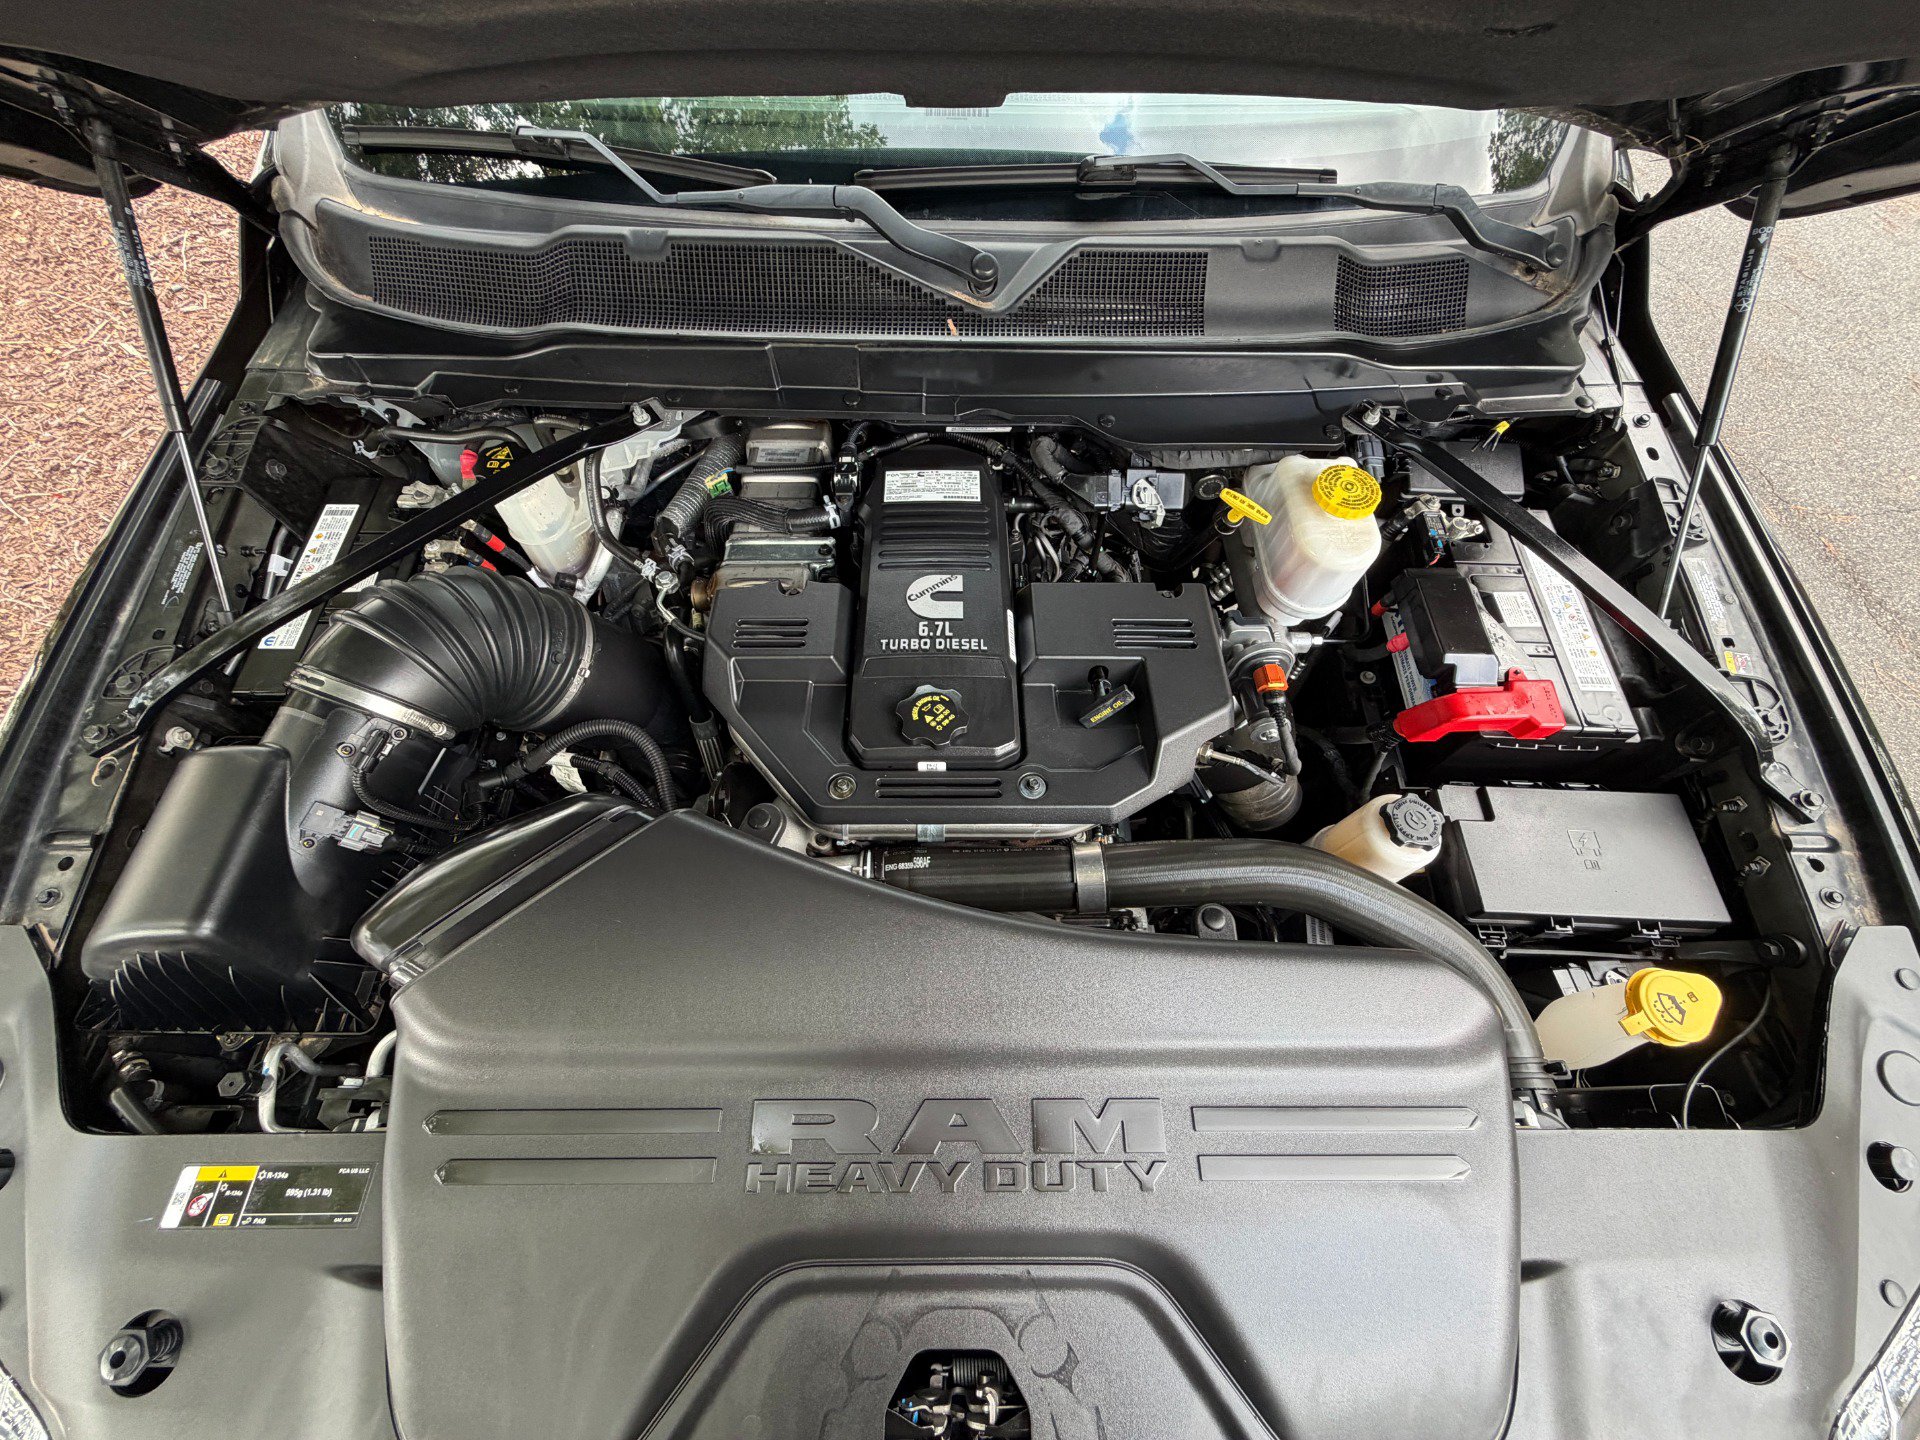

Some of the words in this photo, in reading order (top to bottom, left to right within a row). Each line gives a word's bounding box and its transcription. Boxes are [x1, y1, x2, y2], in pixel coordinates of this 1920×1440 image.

[1737, 248, 1755, 298] STABILUS
[907, 575, 958, 602] Cummins
[918, 621, 954, 637] 6.7L
[880, 638, 931, 651] TURBO
[935, 638, 988, 651] DIESEL
[1090, 706, 1114, 723] ENGINE
[1112, 700, 1125, 709] OIL
[885, 863, 898, 871] ENG
[750, 1097, 1167, 1155] RAM
[266, 1171, 289, 1179] R-134a
[745, 1161, 971, 1194] HEAVY
[985, 1161, 1167, 1193] DUTY
[285, 1188, 304, 1198] 595g
[303, 1188, 322, 1198] (1.31
[322, 1188, 333, 1198] lb)
